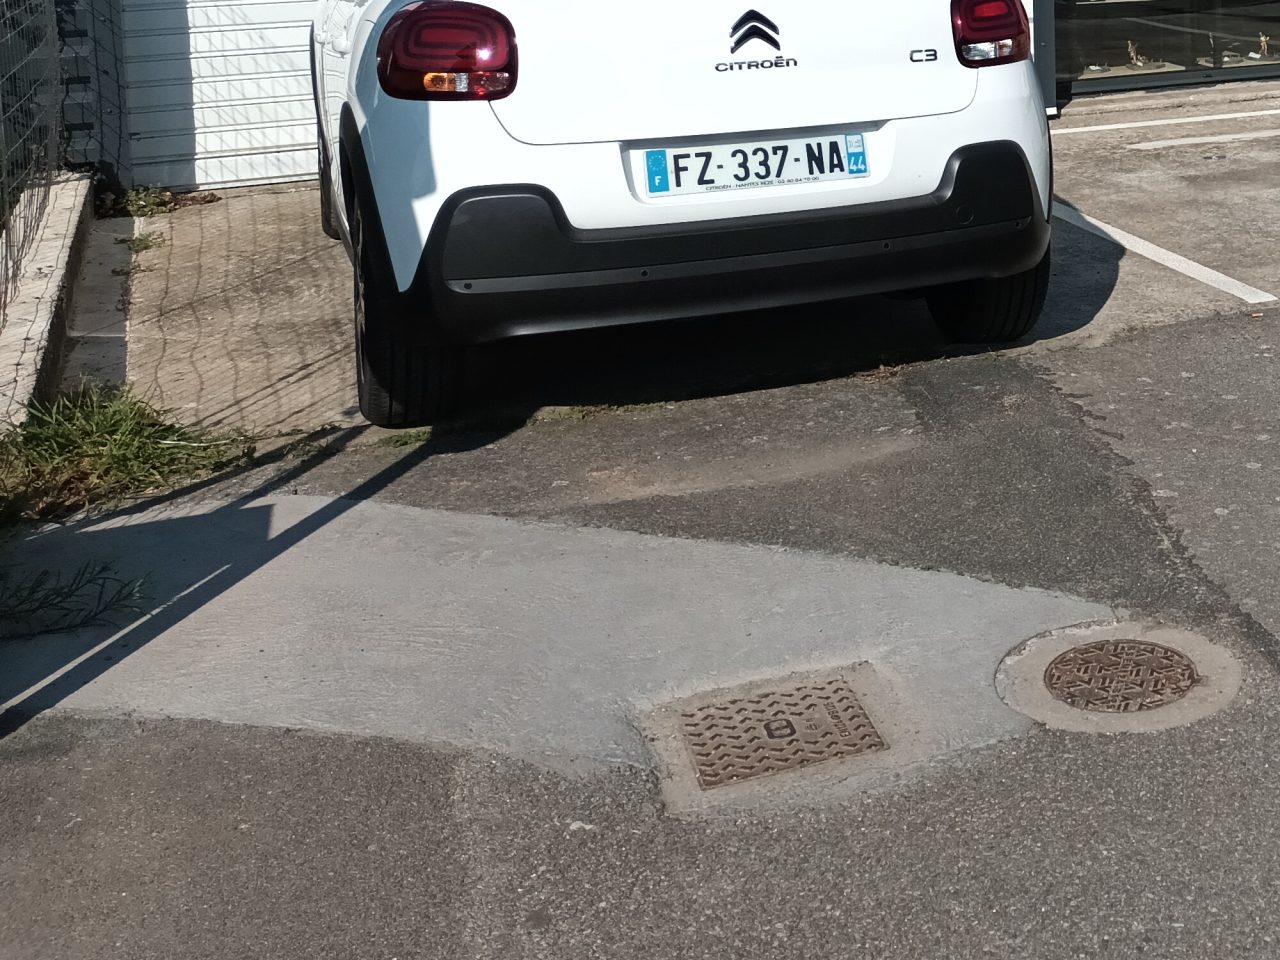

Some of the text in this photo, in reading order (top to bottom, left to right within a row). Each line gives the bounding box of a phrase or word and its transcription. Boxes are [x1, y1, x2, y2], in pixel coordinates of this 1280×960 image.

[910, 48, 938, 62] C3
[655, 141, 845, 187] F FZ-337-NA
[849, 156, 866, 172] 44
